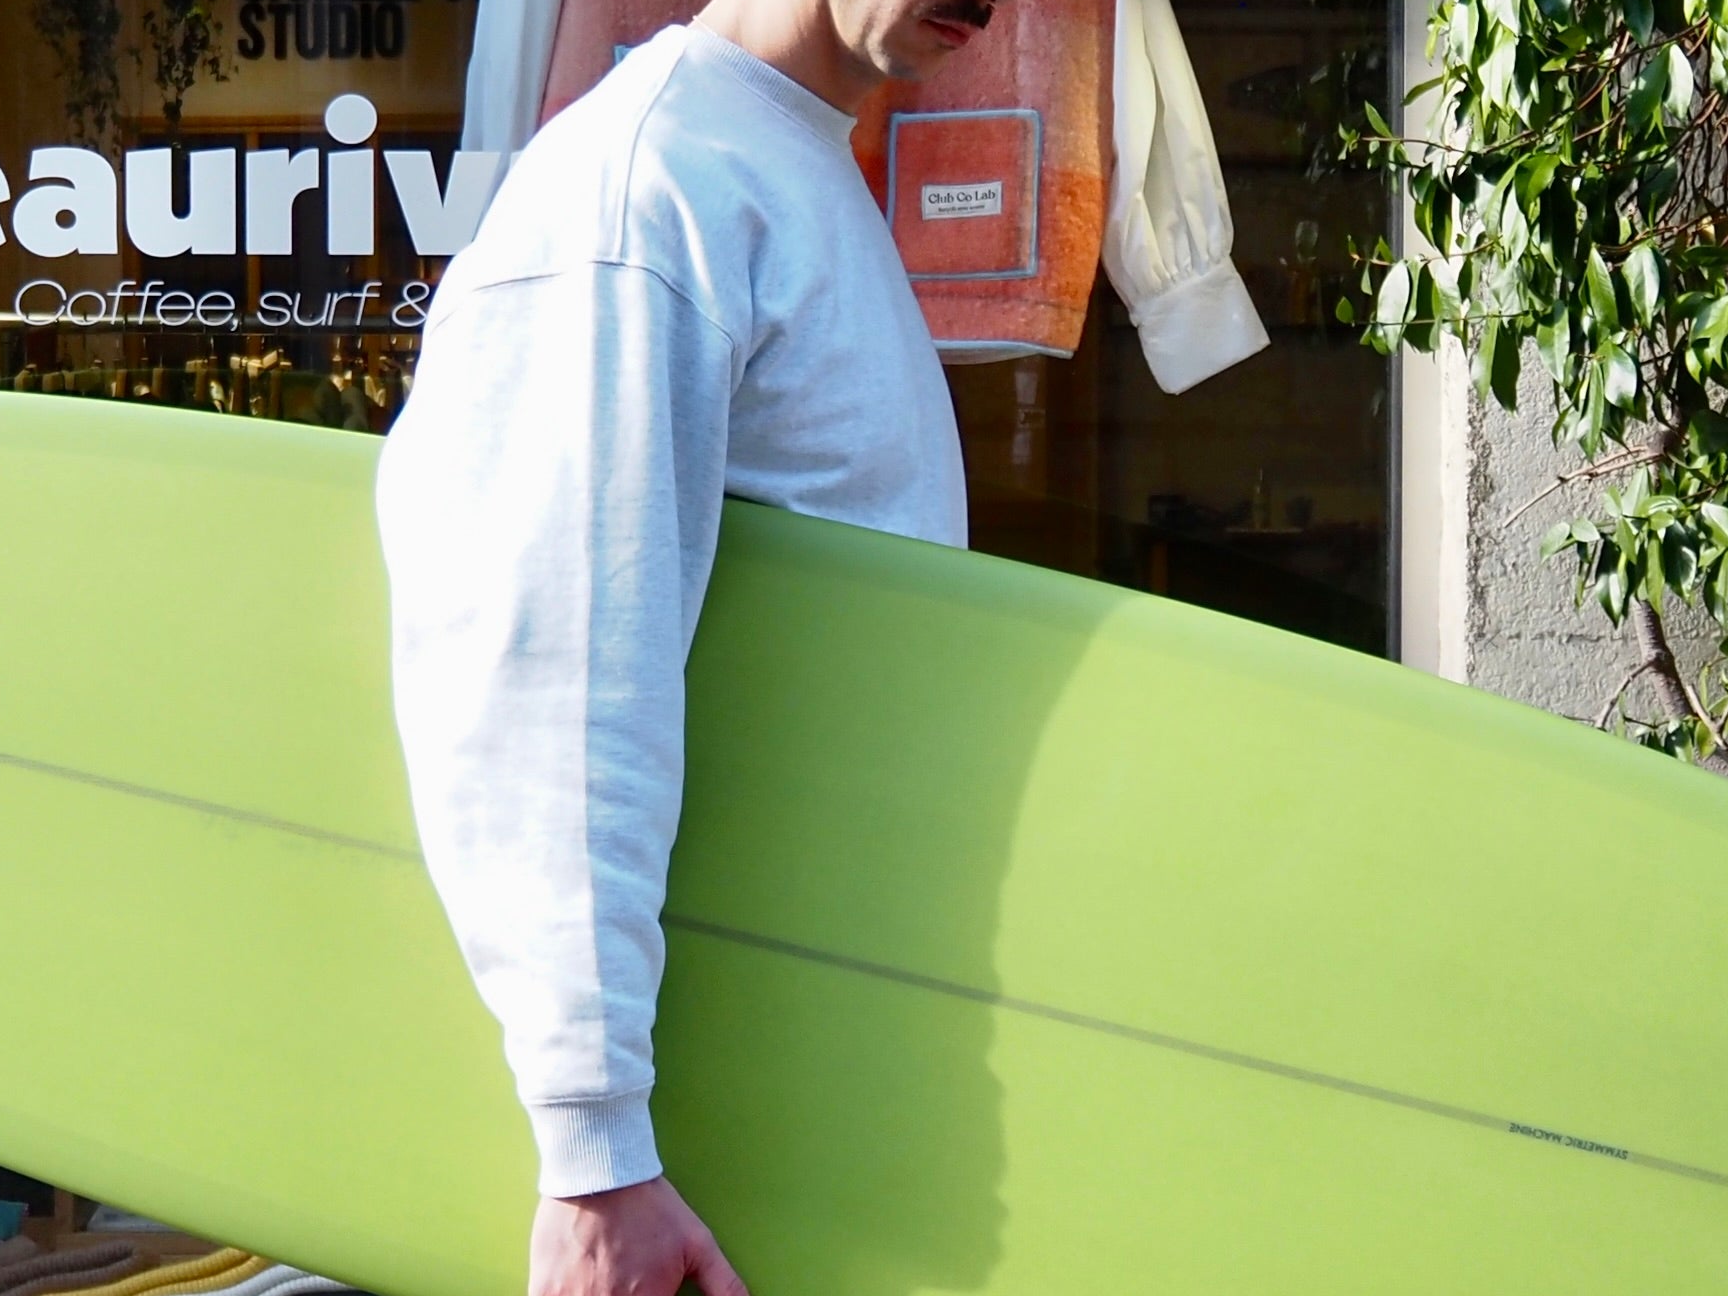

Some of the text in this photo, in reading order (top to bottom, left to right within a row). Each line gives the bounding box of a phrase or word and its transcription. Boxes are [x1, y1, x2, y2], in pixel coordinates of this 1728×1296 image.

[237, 1, 405, 60] STUDIO
[928, 189, 996, 204] Club Co Lab
[15, 279, 432, 332] Coffee, surf &
[1509, 1123, 1628, 1160] SYMMETRIC MACHINE
